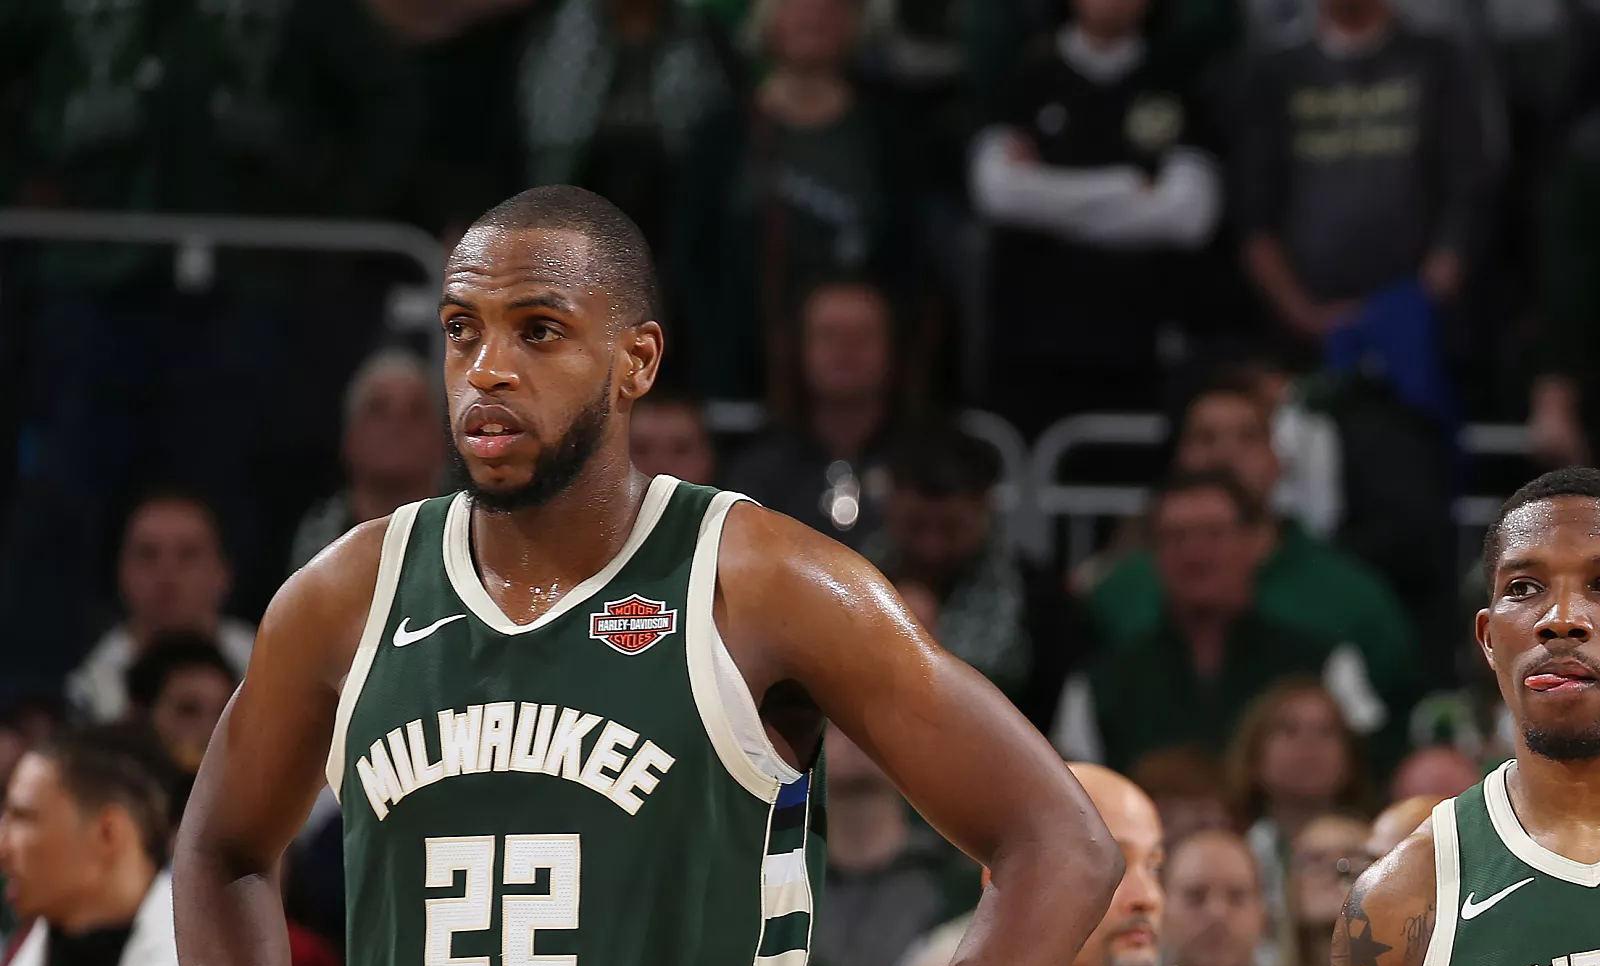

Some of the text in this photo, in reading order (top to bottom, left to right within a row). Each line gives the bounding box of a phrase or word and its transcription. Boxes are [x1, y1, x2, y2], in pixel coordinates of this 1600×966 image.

[615, 602, 654, 615] MOTOR
[597, 617, 669, 632] HARLEY-DAVIDSON
[614, 633, 652, 648] CYCLES
[355, 700, 676, 822] MILWAUKEE
